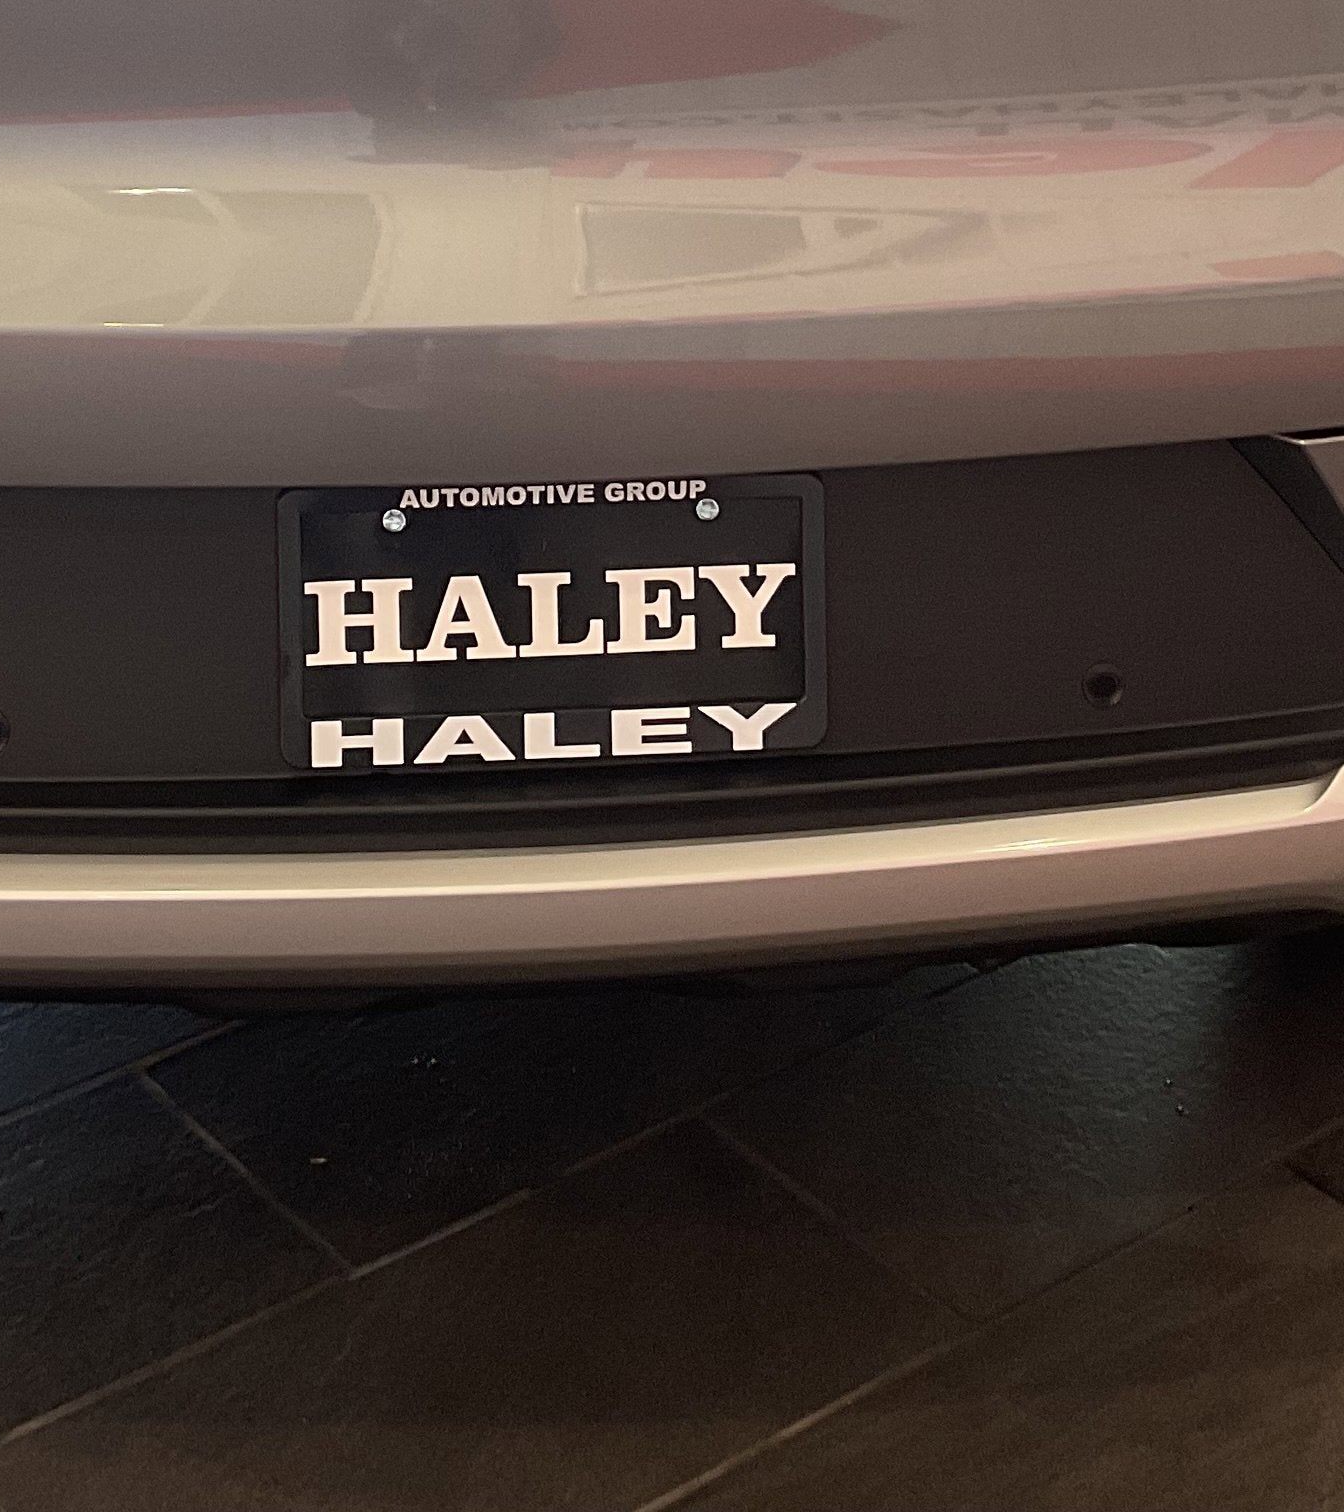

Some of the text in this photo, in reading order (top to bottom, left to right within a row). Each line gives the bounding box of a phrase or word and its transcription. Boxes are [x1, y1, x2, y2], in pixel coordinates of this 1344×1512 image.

[399, 479, 707, 509] AUTOMOTIVE GROUP
[304, 562, 796, 667] HALEY
[311, 702, 797, 768] HALEY
